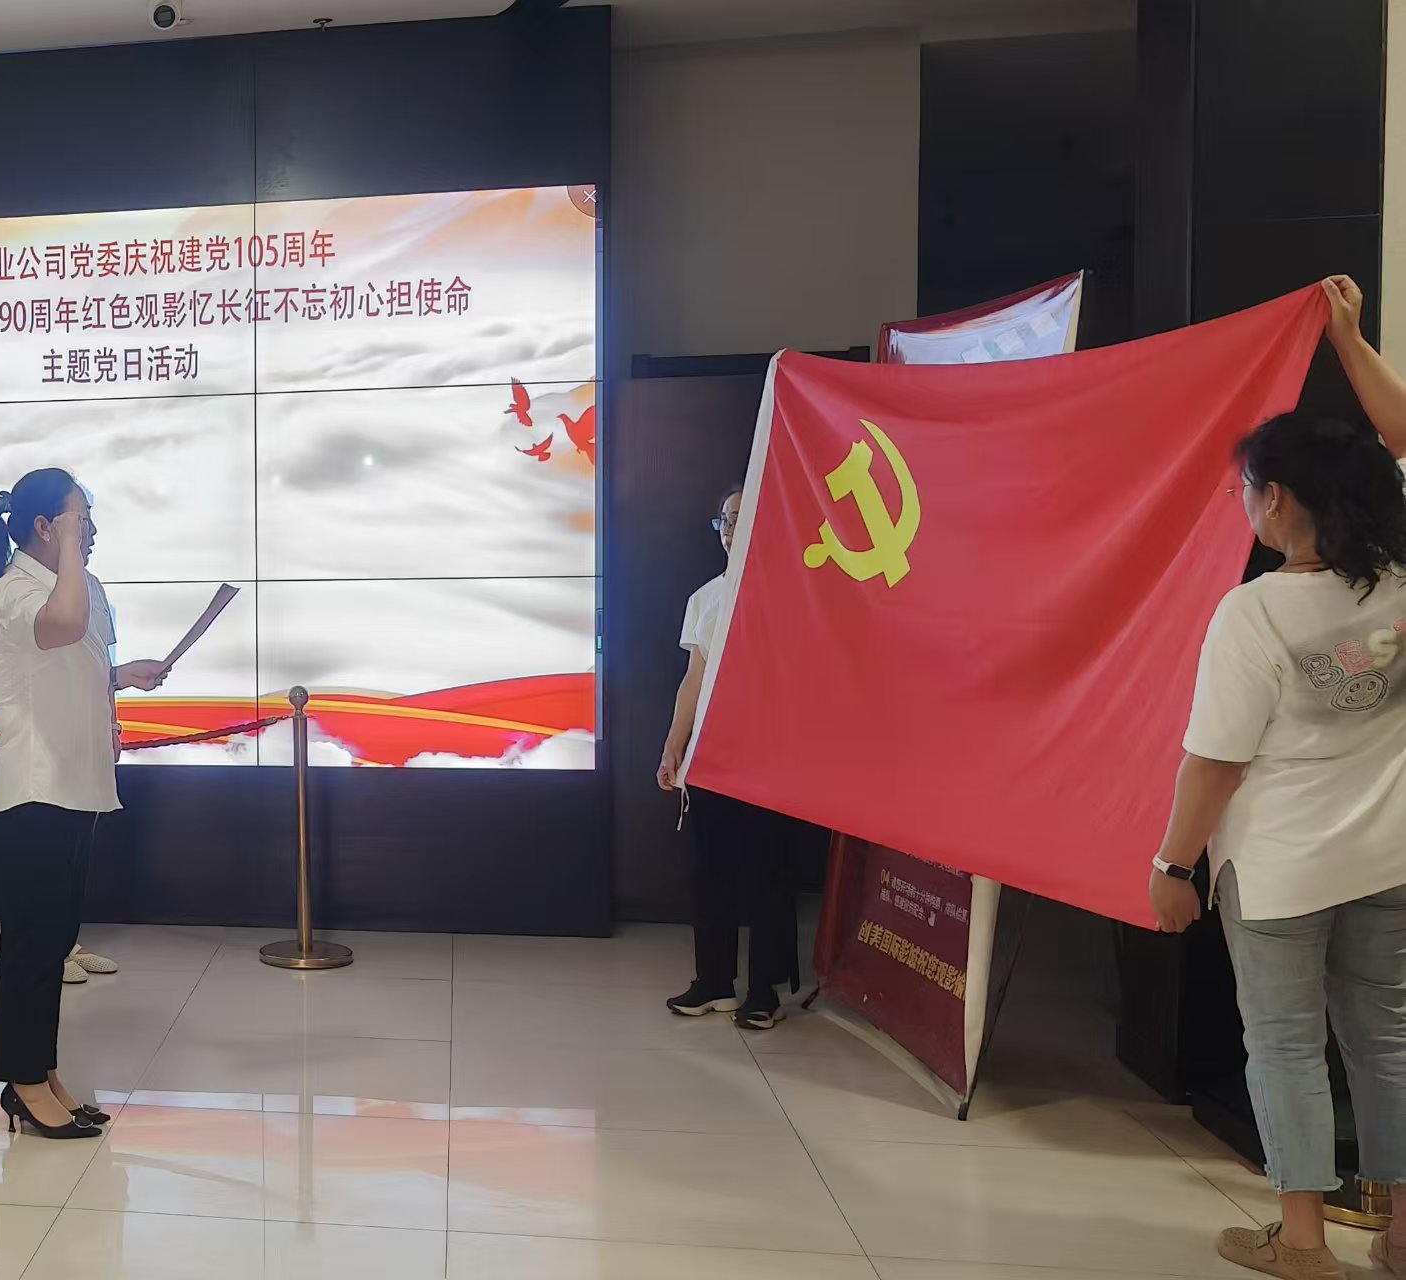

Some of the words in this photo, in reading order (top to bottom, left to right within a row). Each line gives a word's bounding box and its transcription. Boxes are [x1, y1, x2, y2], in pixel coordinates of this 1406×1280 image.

[41, 343, 199, 384] 主题党日活动
